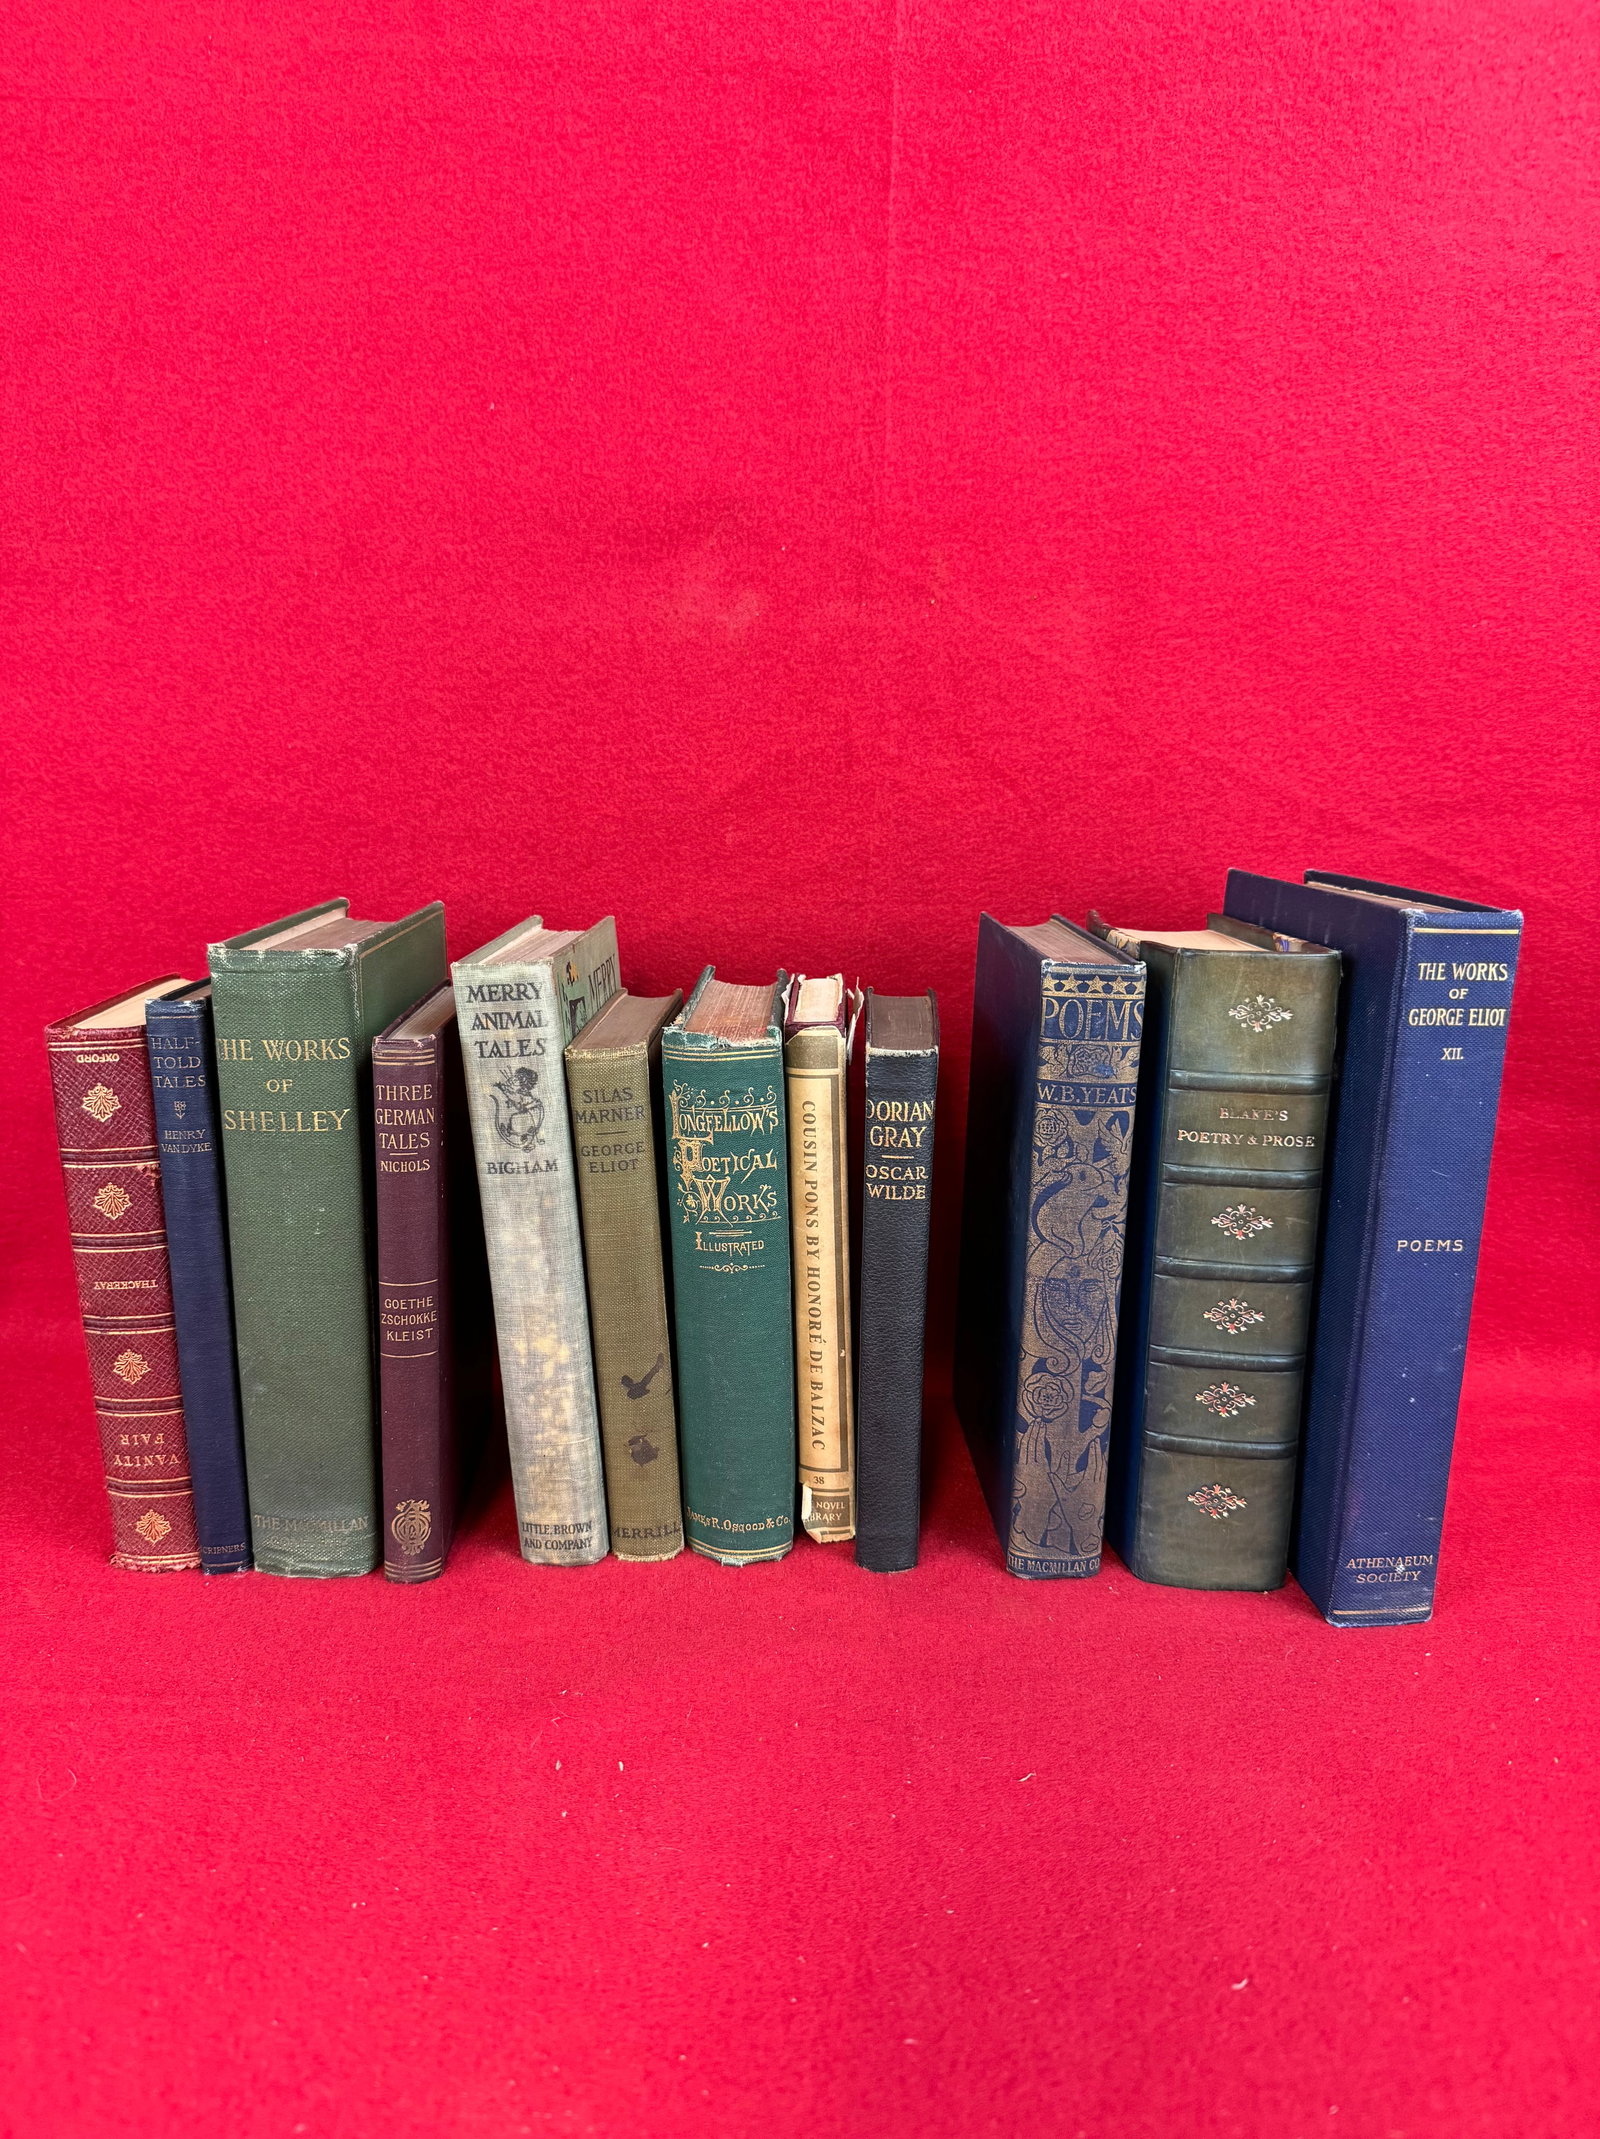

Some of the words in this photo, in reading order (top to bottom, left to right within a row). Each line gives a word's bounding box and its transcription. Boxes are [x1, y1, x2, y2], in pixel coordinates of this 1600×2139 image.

[1418, 963, 1446, 980] THE
[1452, 963, 1508, 981] WORKS
[466, 982, 543, 1003] MERRY
[1448, 988, 1469, 1000] OF
[471, 1010, 548, 1031] ANIMAL
[1040, 997, 1144, 1040] POEMS
[1408, 1008, 1465, 1026] GEORGE
[1468, 1008, 1507, 1026] ELIOT
[151, 1036, 200, 1050] HALF-
[261, 1037, 351, 1061] WORKS
[474, 1037, 547, 1059] TALES
[76, 1053, 119, 1063] OXFORD
[1441, 1047, 1465, 1060] XII.
[153, 1056, 201, 1069] TOLD
[153, 1074, 207, 1088] TALES
[266, 1079, 293, 1093] OF
[375, 1084, 433, 1101] THREE
[582, 1087, 634, 1104] SILAS
[375, 1107, 435, 1126] GERMAN
[575, 1106, 645, 1124] MARNER
[669, 1090, 779, 1145] LONGFELLOW'S
[866, 1099, 934, 1122] DORIAN
[1219, 1107, 1289, 1122] BLAKE'S
[224, 1108, 351, 1132] SHELLEY
[164, 1129, 206, 1140] HENRY
[378, 1132, 431, 1150] TALES
[801, 1100, 818, 1172] COUSIN
[870, 1126, 928, 1148] GRAY
[1177, 1129, 1244, 1146] POETRY
[1247, 1135, 1259, 1146] &
[1262, 1134, 1316, 1148] PROSE
[581, 1141, 646, 1157] GEORGE
[380, 1158, 431, 1172] NICHOLS
[486, 1158, 559, 1175] BIGHAM
[589, 1158, 640, 1174] ELIOT
[673, 1137, 778, 1192] POETICAL
[865, 1164, 929, 1181] OSCAR
[866, 1182, 927, 1200] WILDE
[693, 1174, 778, 1228] WORKS
[804, 1179, 819, 1228] PONS
[695, 1231, 766, 1257] ILLUSTRATED
[806, 1236, 820, 1260] BY
[1397, 1239, 1464, 1252] POEMS
[94, 1280, 159, 1290] THACKERAY
[384, 1296, 434, 1310] GOETHE
[807, 1266, 828, 1343] HONORÉ
[381, 1310, 438, 1326] ZSCHOKKE
[386, 1327, 434, 1342] KLEIST
[810, 1349, 824, 1374] DE
[810, 1381, 826, 1451] BALZAC
[120, 1433, 165, 1446] FAIR
[113, 1454, 181, 1467] VANITY
[813, 1475, 825, 1485] 38
[816, 1501, 845, 1510] NOVEL
[254, 1514, 280, 1530] THE
[805, 1512, 842, 1525] BRARY
[611, 1521, 681, 1539] MERRILL
[200, 1541, 246, 1555] CRIBNERS
[524, 1537, 542, 1549] AND
[544, 1536, 593, 1551] COMPANY
[1008, 1556, 1025, 1570] THE
[1027, 1559, 1087, 1574] MACMILLAN
[1355, 1571, 1422, 1584] SOCIETY
